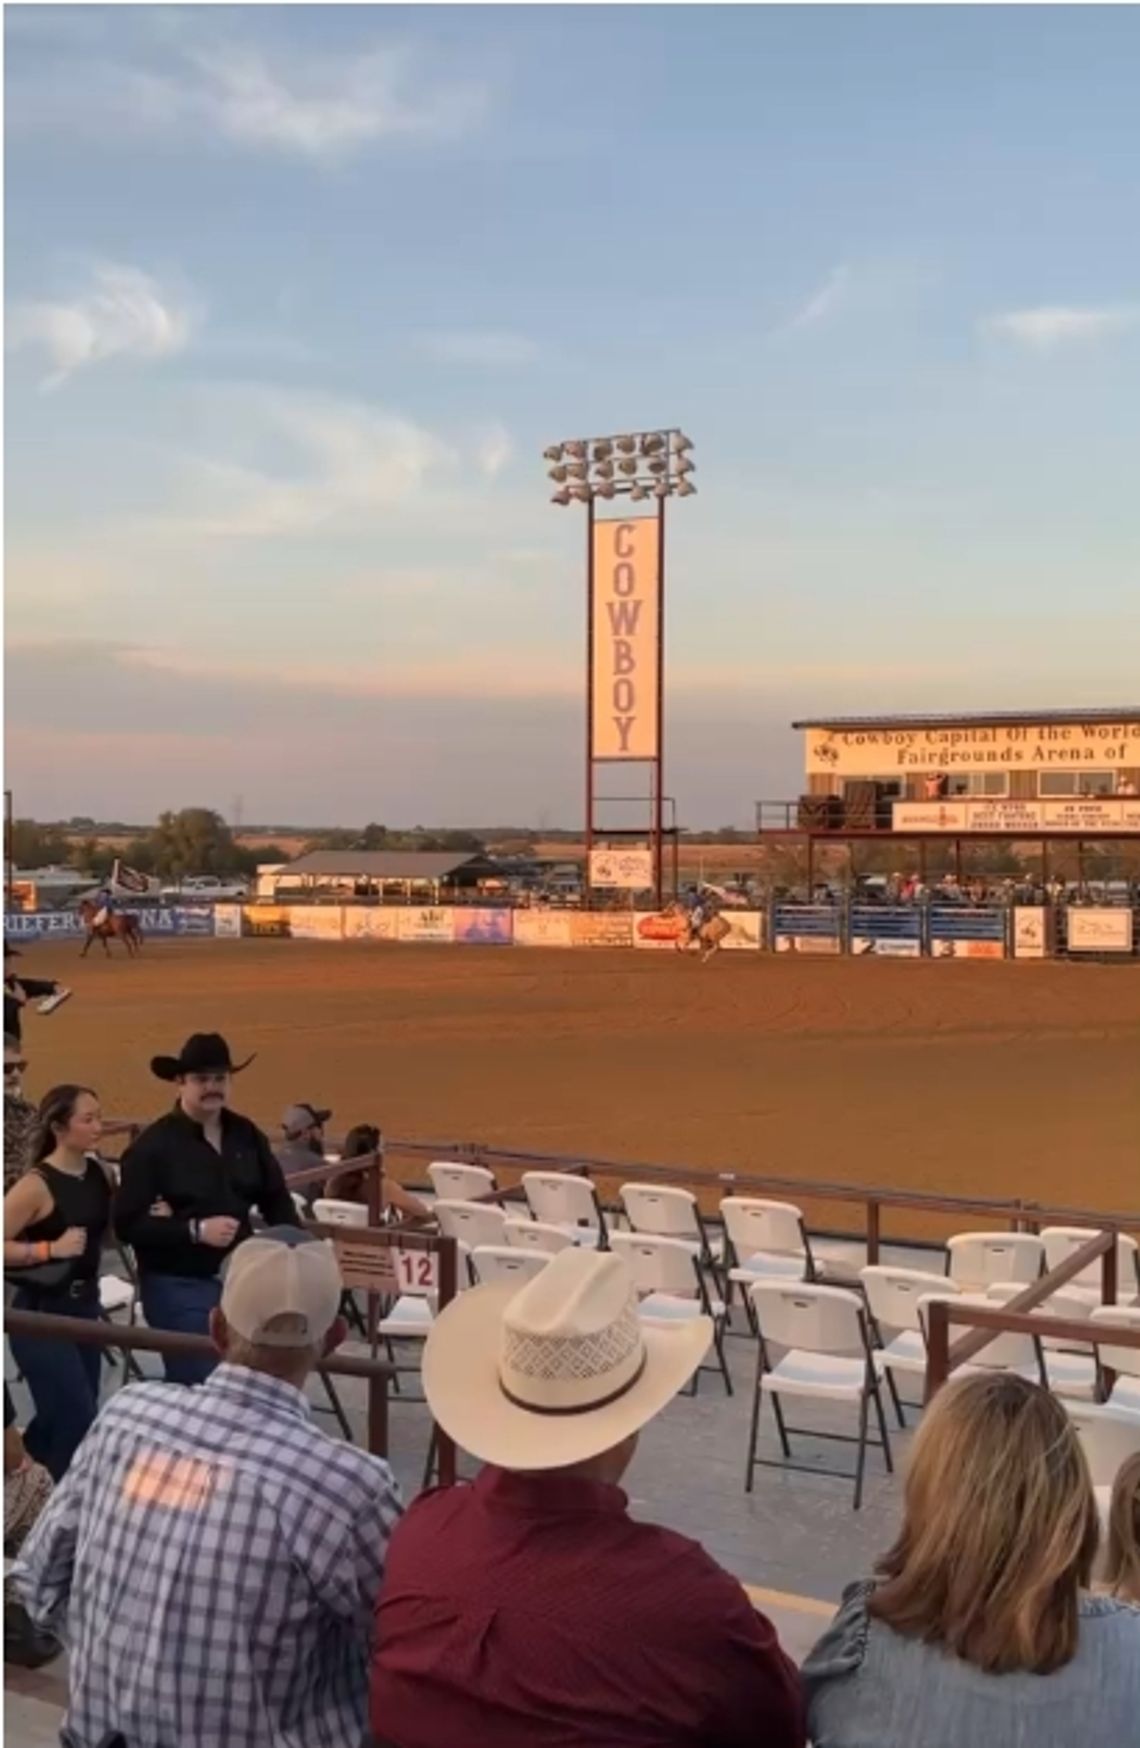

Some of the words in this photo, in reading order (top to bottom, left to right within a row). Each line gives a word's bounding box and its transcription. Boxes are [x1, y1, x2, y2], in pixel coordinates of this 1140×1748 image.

[605, 523, 643, 751] COWBOY
[841, 730, 914, 748] Cowboy
[925, 728, 998, 747] Capital
[1038, 725, 1073, 741] the
[896, 747, 1025, 766] Fairgrounds
[1032, 745, 1095, 761] Arena
[1103, 743, 1127, 760] of
[401, 1255, 433, 1287] 12
